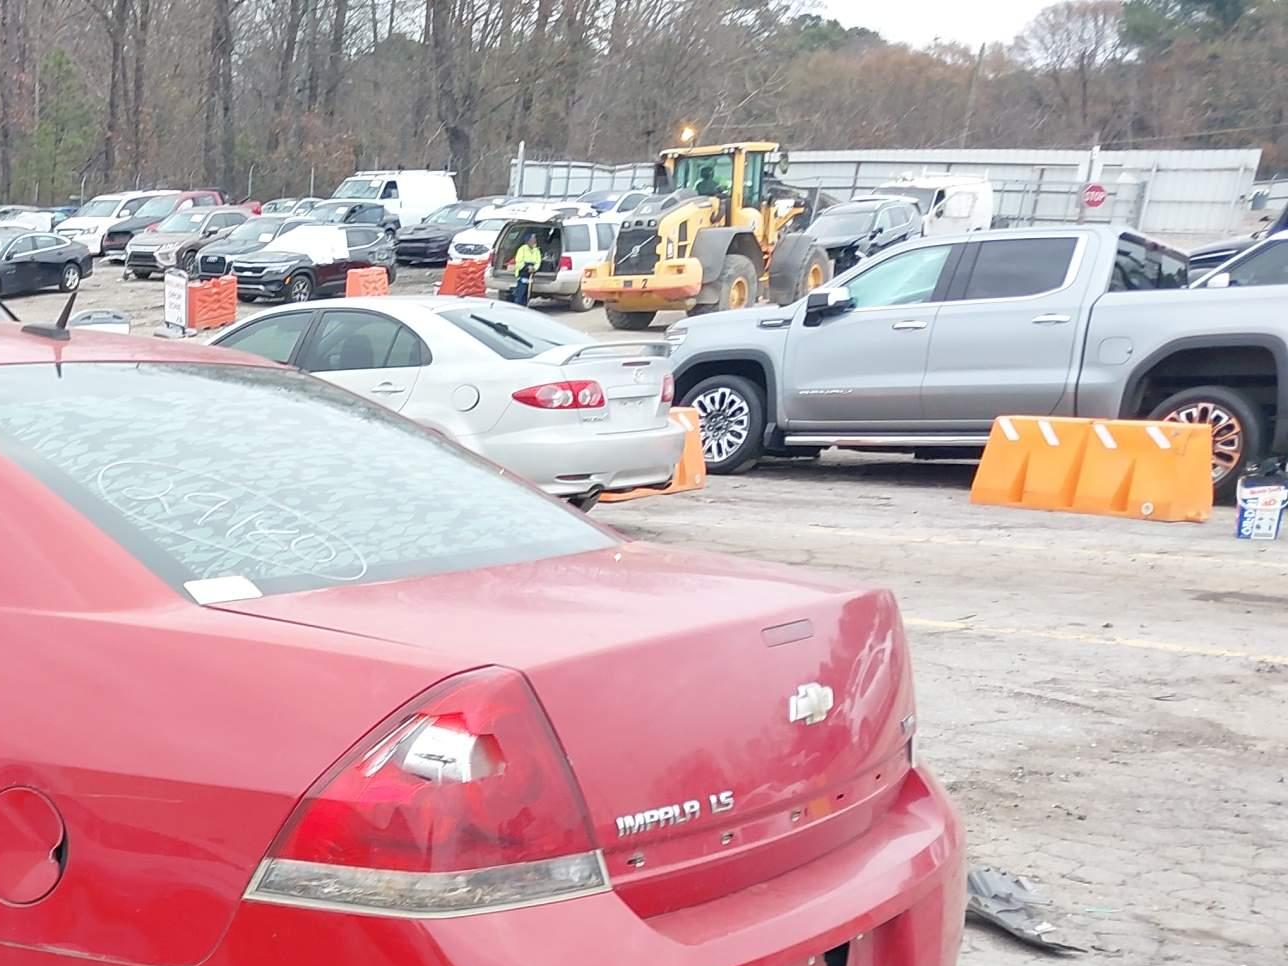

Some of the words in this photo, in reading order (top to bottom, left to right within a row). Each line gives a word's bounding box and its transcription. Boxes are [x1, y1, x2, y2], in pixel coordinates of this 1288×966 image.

[1084, 190, 1106, 202] STOP
[641, 278, 648, 289] 2
[616, 800, 700, 837] IMPALA
[709, 790, 734, 813] LS
